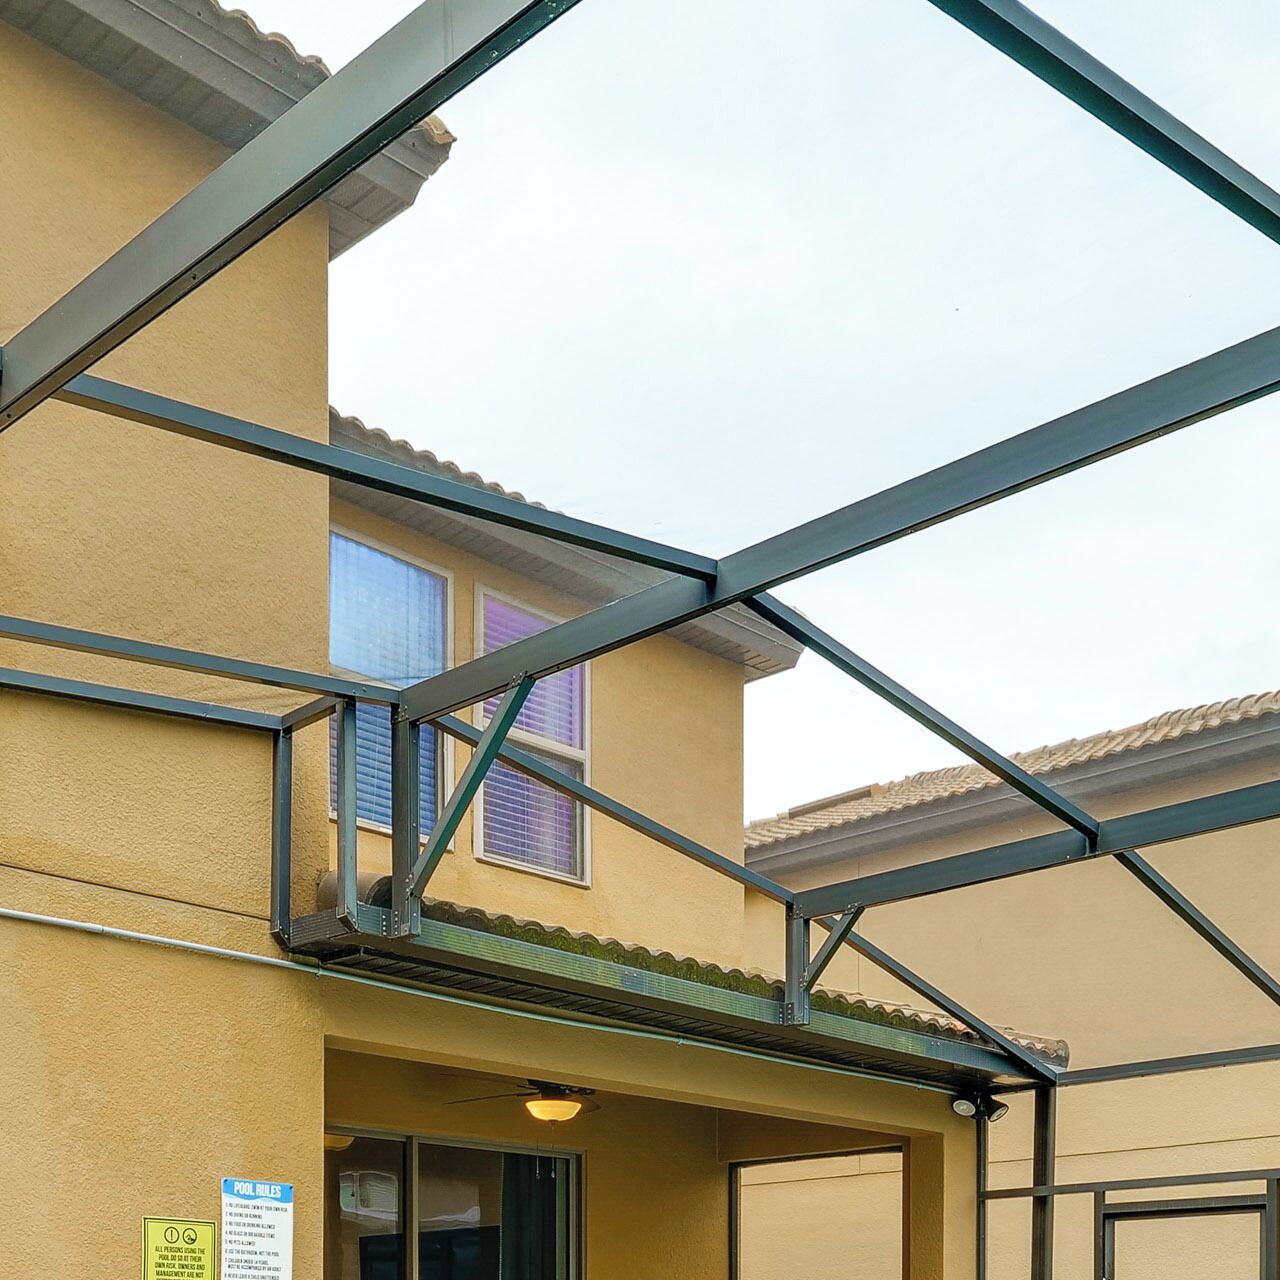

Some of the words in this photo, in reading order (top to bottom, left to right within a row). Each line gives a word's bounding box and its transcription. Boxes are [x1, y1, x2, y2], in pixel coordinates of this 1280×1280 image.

[234, 1181, 255, 1196] POOL
[256, 1183, 282, 1198] RULES
[196, 1263, 205, 1271] AND
